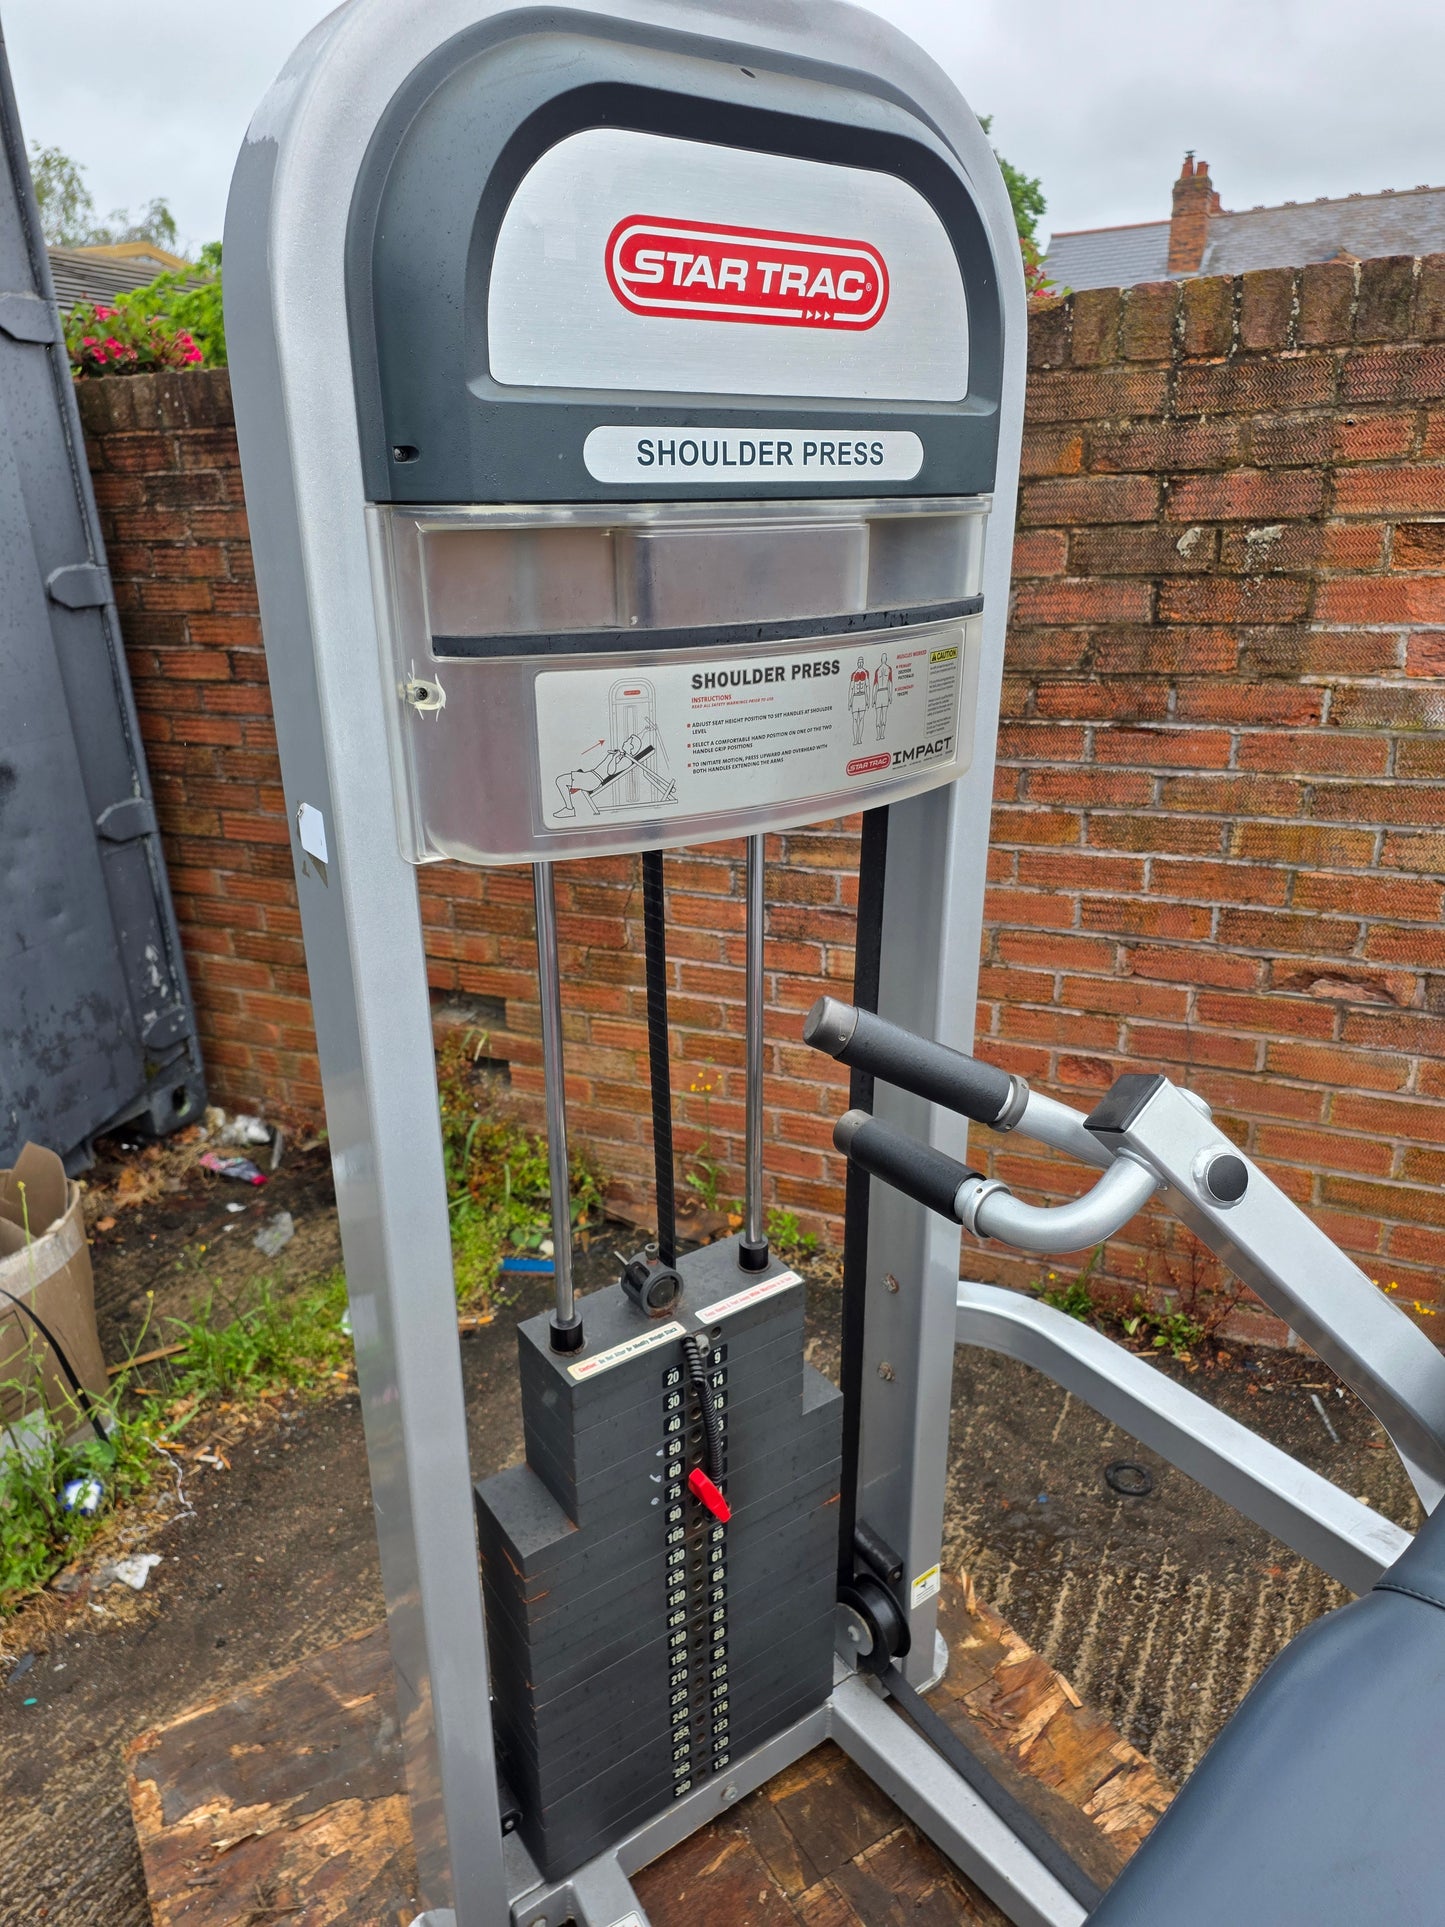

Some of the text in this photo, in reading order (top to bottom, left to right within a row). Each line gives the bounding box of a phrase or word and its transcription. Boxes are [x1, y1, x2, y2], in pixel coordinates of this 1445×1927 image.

[624, 249, 866, 301] STAR TRAC
[636, 439, 884, 466] SHOULDER PRESS
[936, 649, 957, 661] CAUTION
[691, 659, 841, 690] SHOULDER PRESS
[691, 694, 732, 704] INSTRUCTIONS
[692, 720, 711, 728] ADJUST
[724, 717, 744, 725] HEIGHT
[783, 710, 804, 718] HANDLES
[810, 705, 833, 714] SHOULDER
[715, 736, 750, 745] COMFORTABLE
[766, 731, 788, 739] POSITION
[692, 747, 714, 755] HANDLE
[727, 743, 753, 751] POSITIONS
[700, 759, 721, 767] INITIATE
[722, 756, 744, 764] MOTION,
[744, 753, 759, 761] PRESS
[759, 751, 781, 759] UPWARD
[792, 745, 815, 754] OVERHEAD
[815, 743, 828, 751] WITH
[849, 762, 869, 772] STAR
[869, 757, 888, 768] TRAC
[892, 736, 953, 765] IMPACT
[707, 765, 731, 773] HANDLES
[732, 760, 760, 769] EXTENDING
[714, 1351, 721, 1364] 9
[667, 1370, 680, 1386] 20
[712, 1373, 724, 1388] 14
[667, 1394, 680, 1409] 30
[713, 1396, 724, 1409] 18
[668, 1417, 681, 1432] 40
[668, 1440, 682, 1456] 50
[668, 1463, 682, 1478] 60
[669, 1484, 682, 1500] 75
[669, 1507, 682, 1522] 90
[667, 1527, 685, 1544] 105
[712, 1527, 724, 1542] 55
[668, 1548, 686, 1566] 120
[711, 1548, 723, 1562] 61
[667, 1569, 685, 1586] 135
[669, 1589, 686, 1606] 150
[712, 1588, 724, 1602] 75
[669, 1610, 686, 1627] 165
[713, 1608, 725, 1622] 82
[670, 1630, 687, 1647] 180
[713, 1627, 725, 1641] 89
[671, 1649, 688, 1666] 195
[713, 1646, 725, 1660] 95
[671, 1668, 688, 1686] 210
[712, 1663, 727, 1680] 102
[671, 1688, 688, 1705] 225
[712, 1682, 728, 1698] 109
[672, 1707, 689, 1724] 240
[713, 1700, 729, 1717] 116
[673, 1725, 690, 1742] 255
[713, 1718, 728, 1734] 123
[673, 1743, 690, 1760] 270
[713, 1736, 729, 1752] 130
[674, 1761, 691, 1778] 285
[674, 1780, 691, 1797] 300
